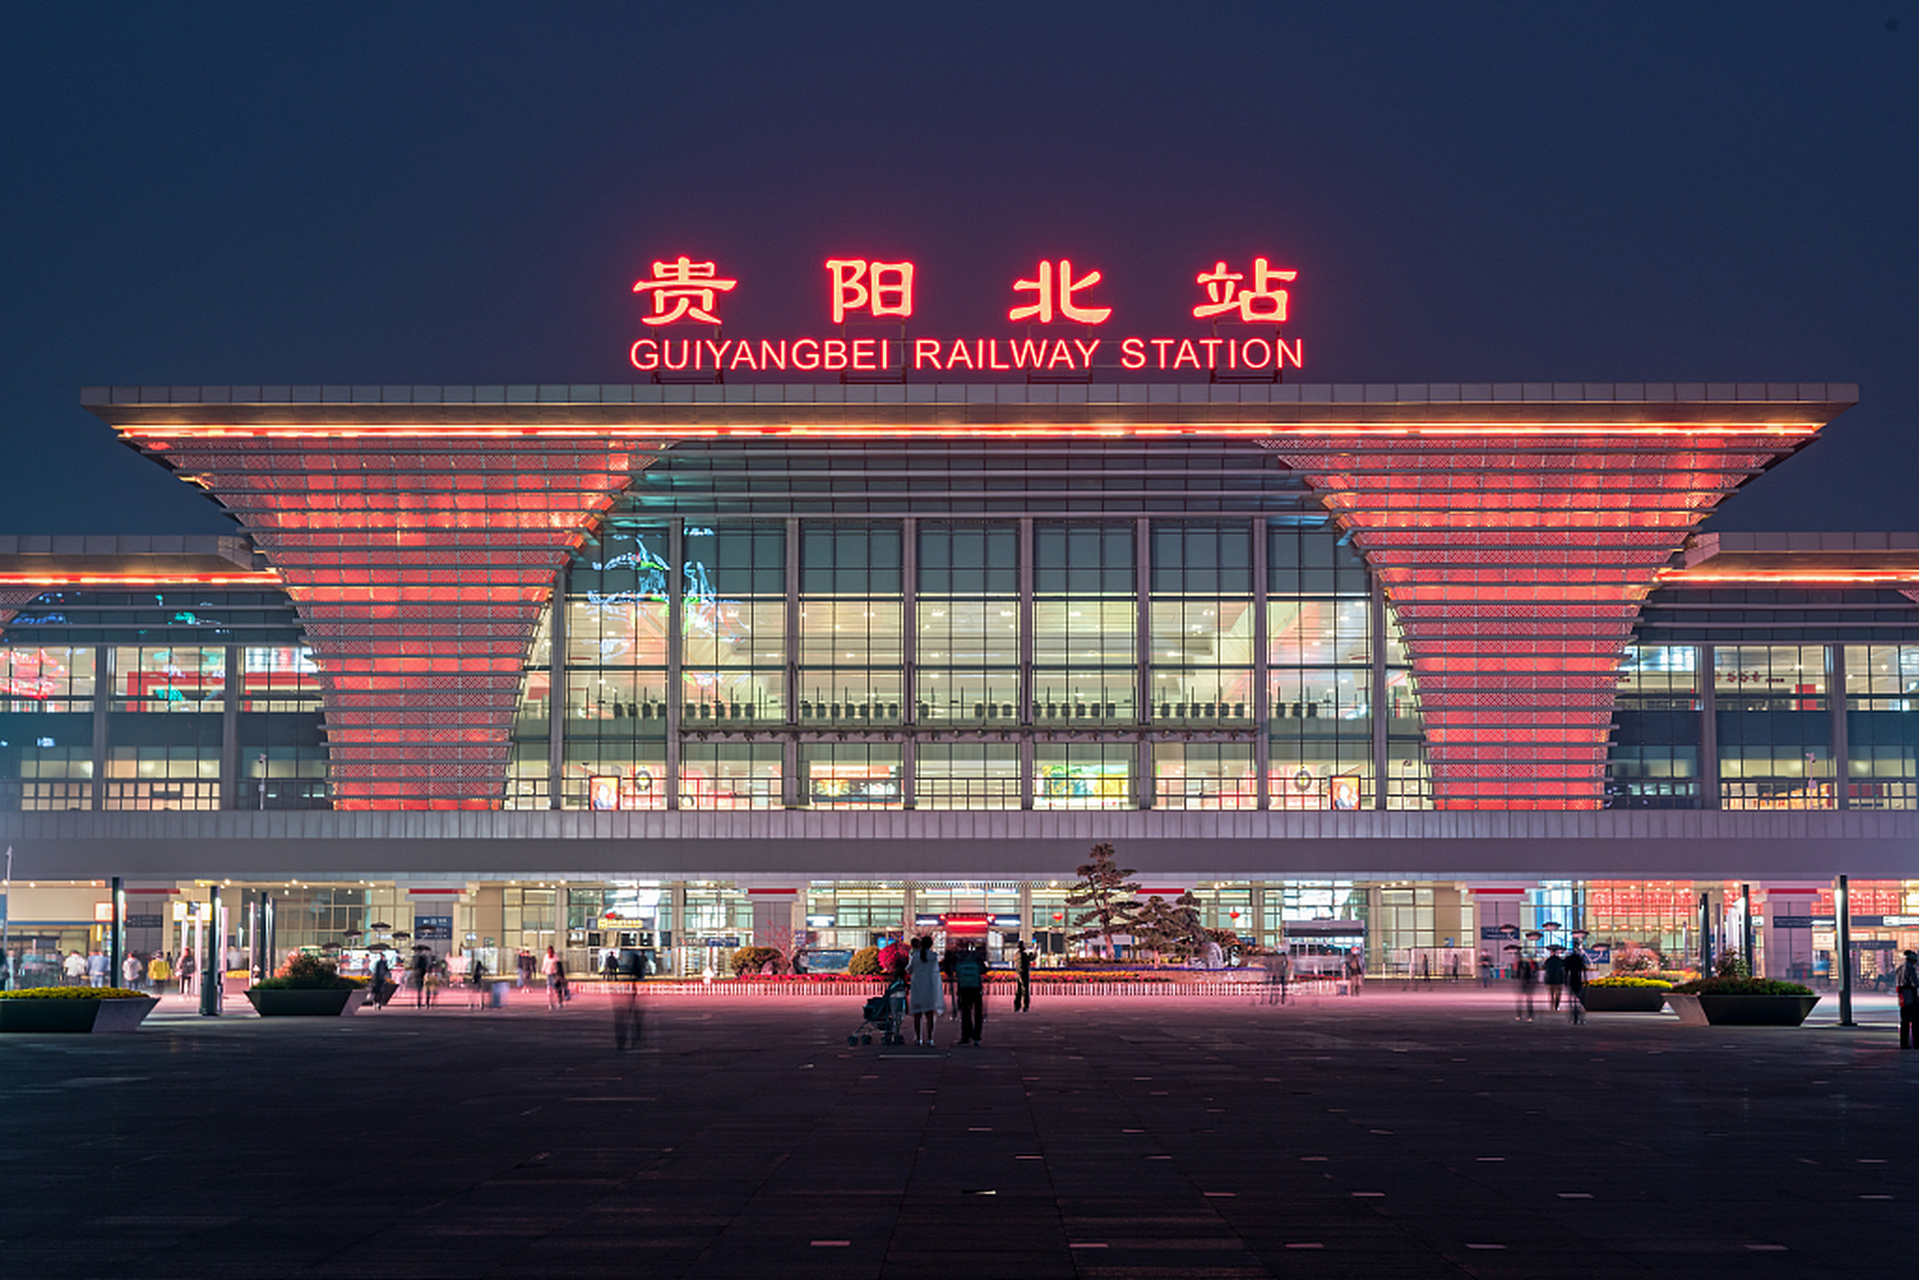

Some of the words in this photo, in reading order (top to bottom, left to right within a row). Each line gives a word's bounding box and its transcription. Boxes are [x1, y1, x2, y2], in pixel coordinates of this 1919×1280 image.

[632, 256, 1297, 324] 贵阳北站
[629, 338, 888, 370] GUIYANGBEI
[914, 338, 1100, 369] RAILWAY
[1121, 338, 1303, 370] STATION
